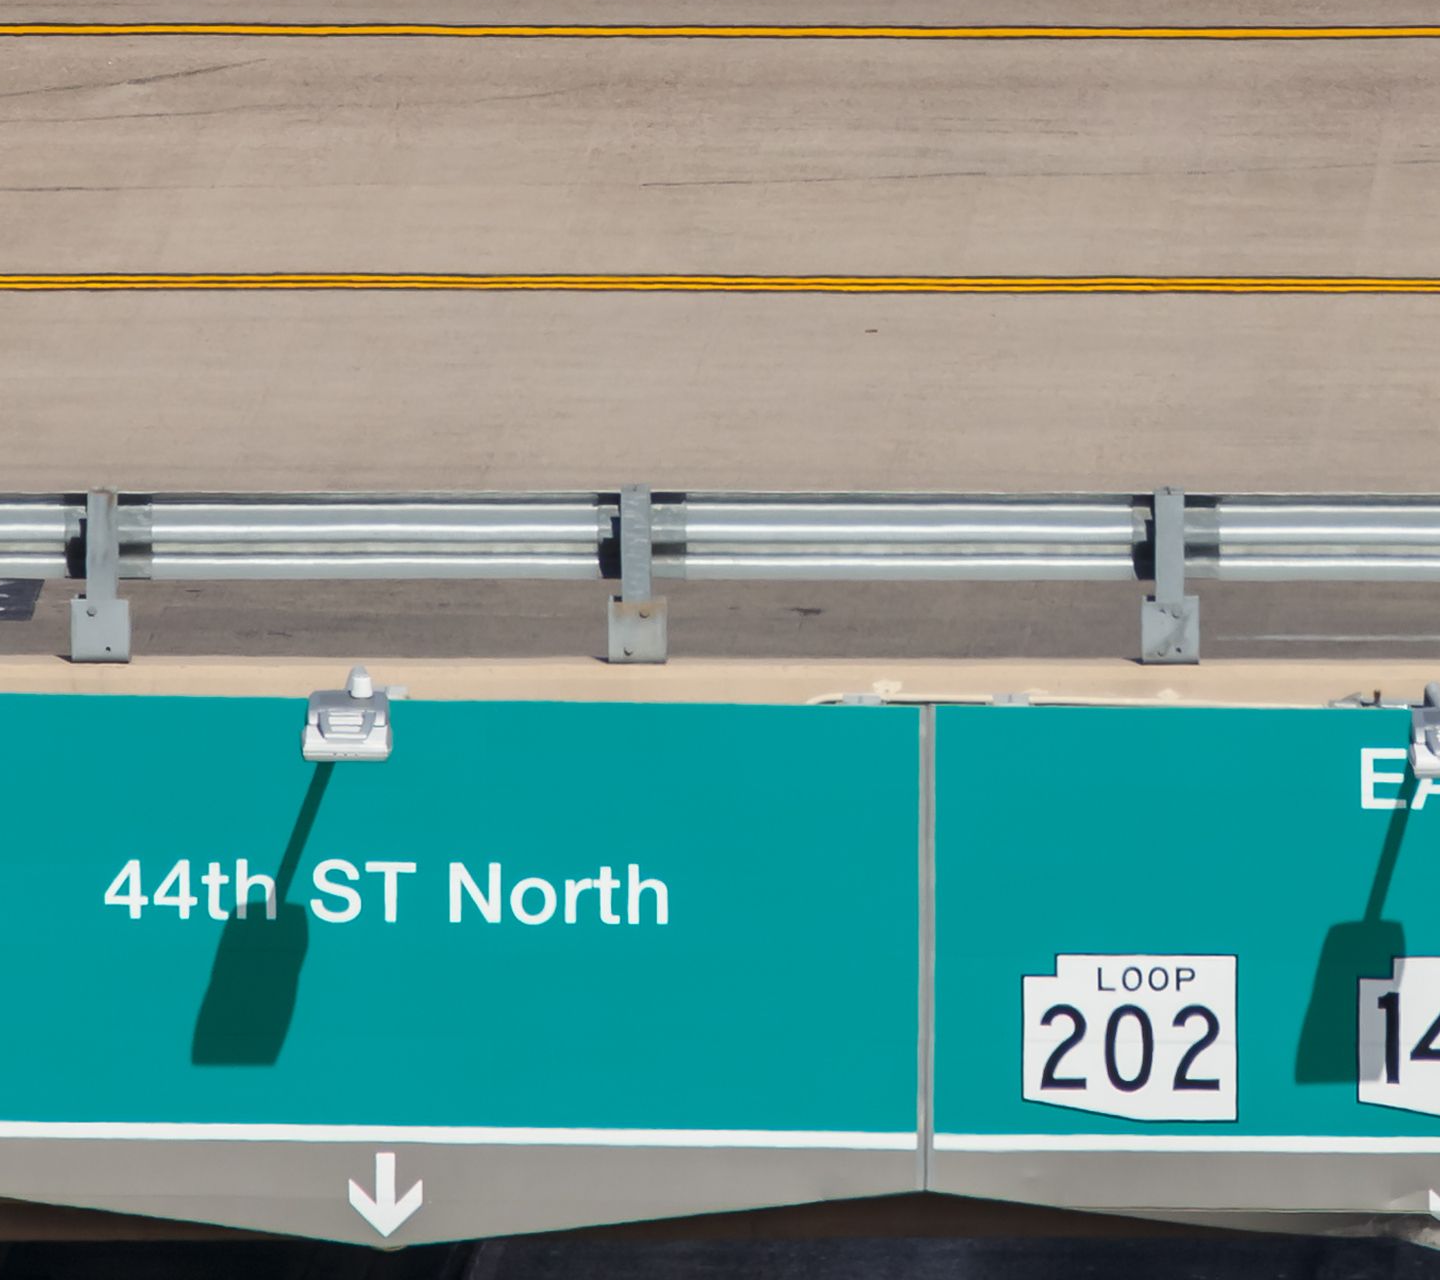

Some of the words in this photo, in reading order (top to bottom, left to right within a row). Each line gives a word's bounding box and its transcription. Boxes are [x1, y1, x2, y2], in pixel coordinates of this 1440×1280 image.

[104, 858, 278, 921] 44th
[310, 858, 417, 923] ST
[449, 861, 670, 925] North
[1096, 966, 1197, 992] LOOP
[1040, 1003, 1221, 1092] 202
